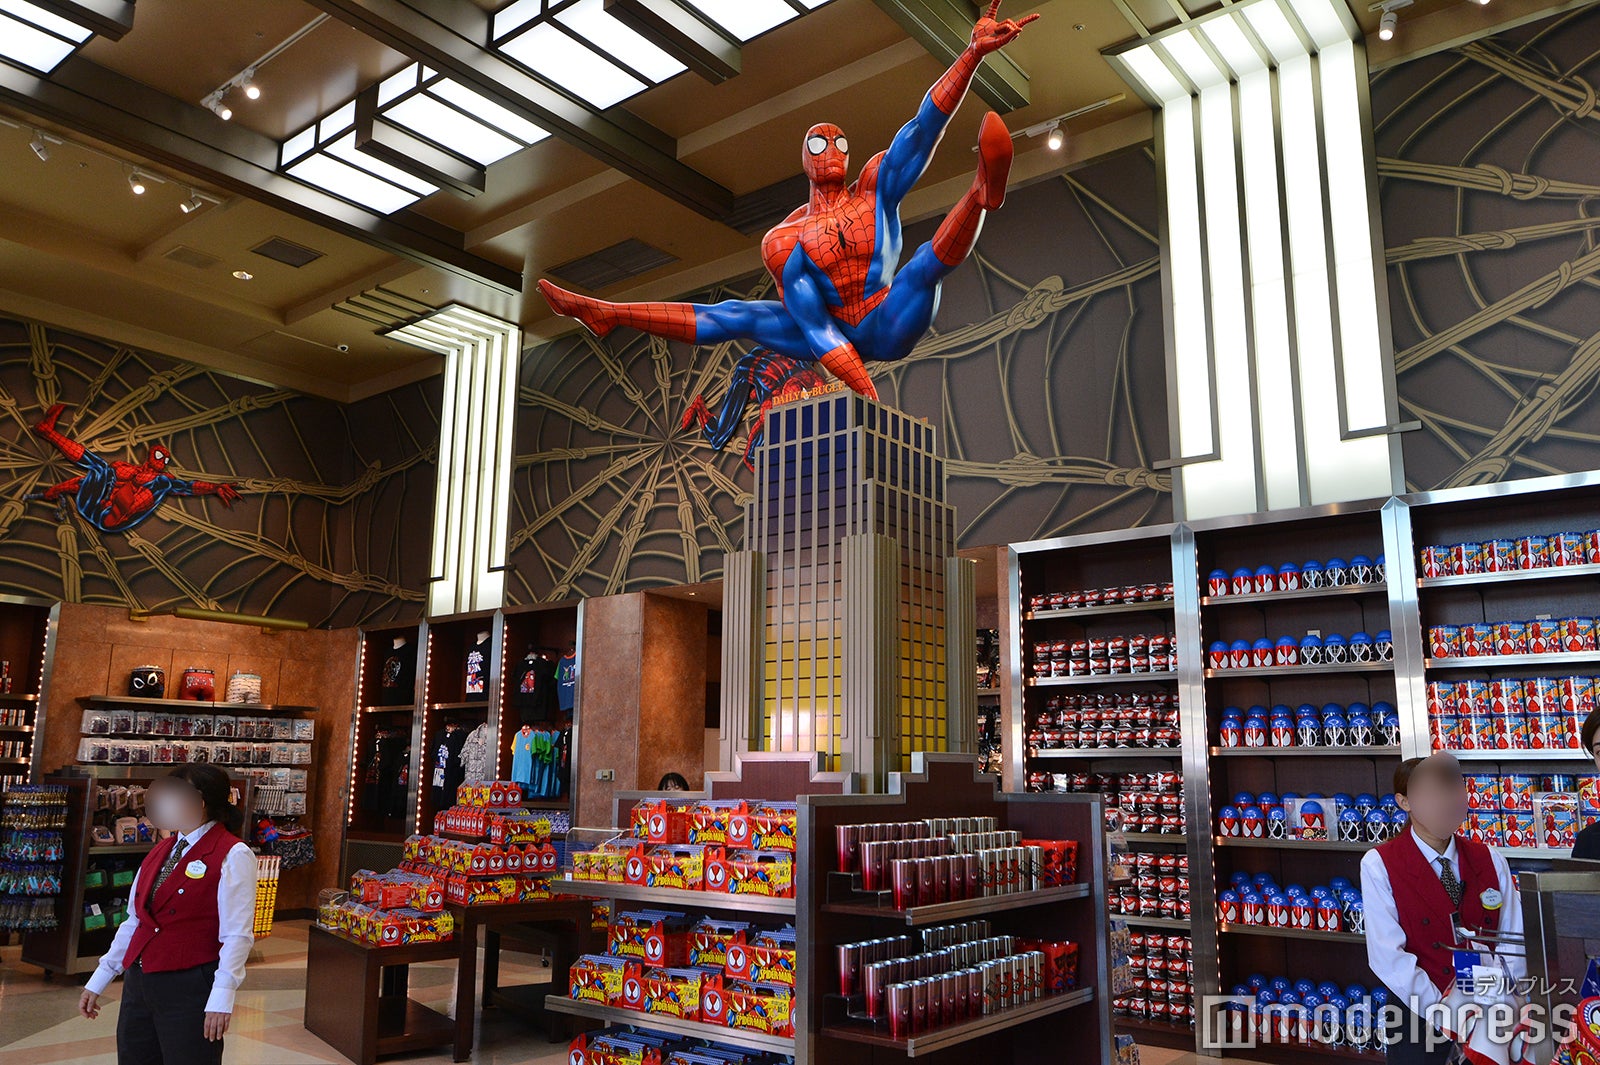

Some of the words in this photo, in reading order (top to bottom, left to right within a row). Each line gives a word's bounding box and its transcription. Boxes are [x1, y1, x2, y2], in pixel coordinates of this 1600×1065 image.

[772, 391, 801, 406] DAILY
[812, 381, 846, 397] BUGLE
[761, 834, 793, 849] SPIDER-MAN
[654, 874, 683, 888] SPIDER-MAN
[737, 880, 769, 896] SPIDER-MAN
[759, 967, 793, 984] SPIDER-MAN
[651, 1000, 680, 1016] SPIDER-MAN
[735, 1013, 767, 1031] SPIDER-MAN
